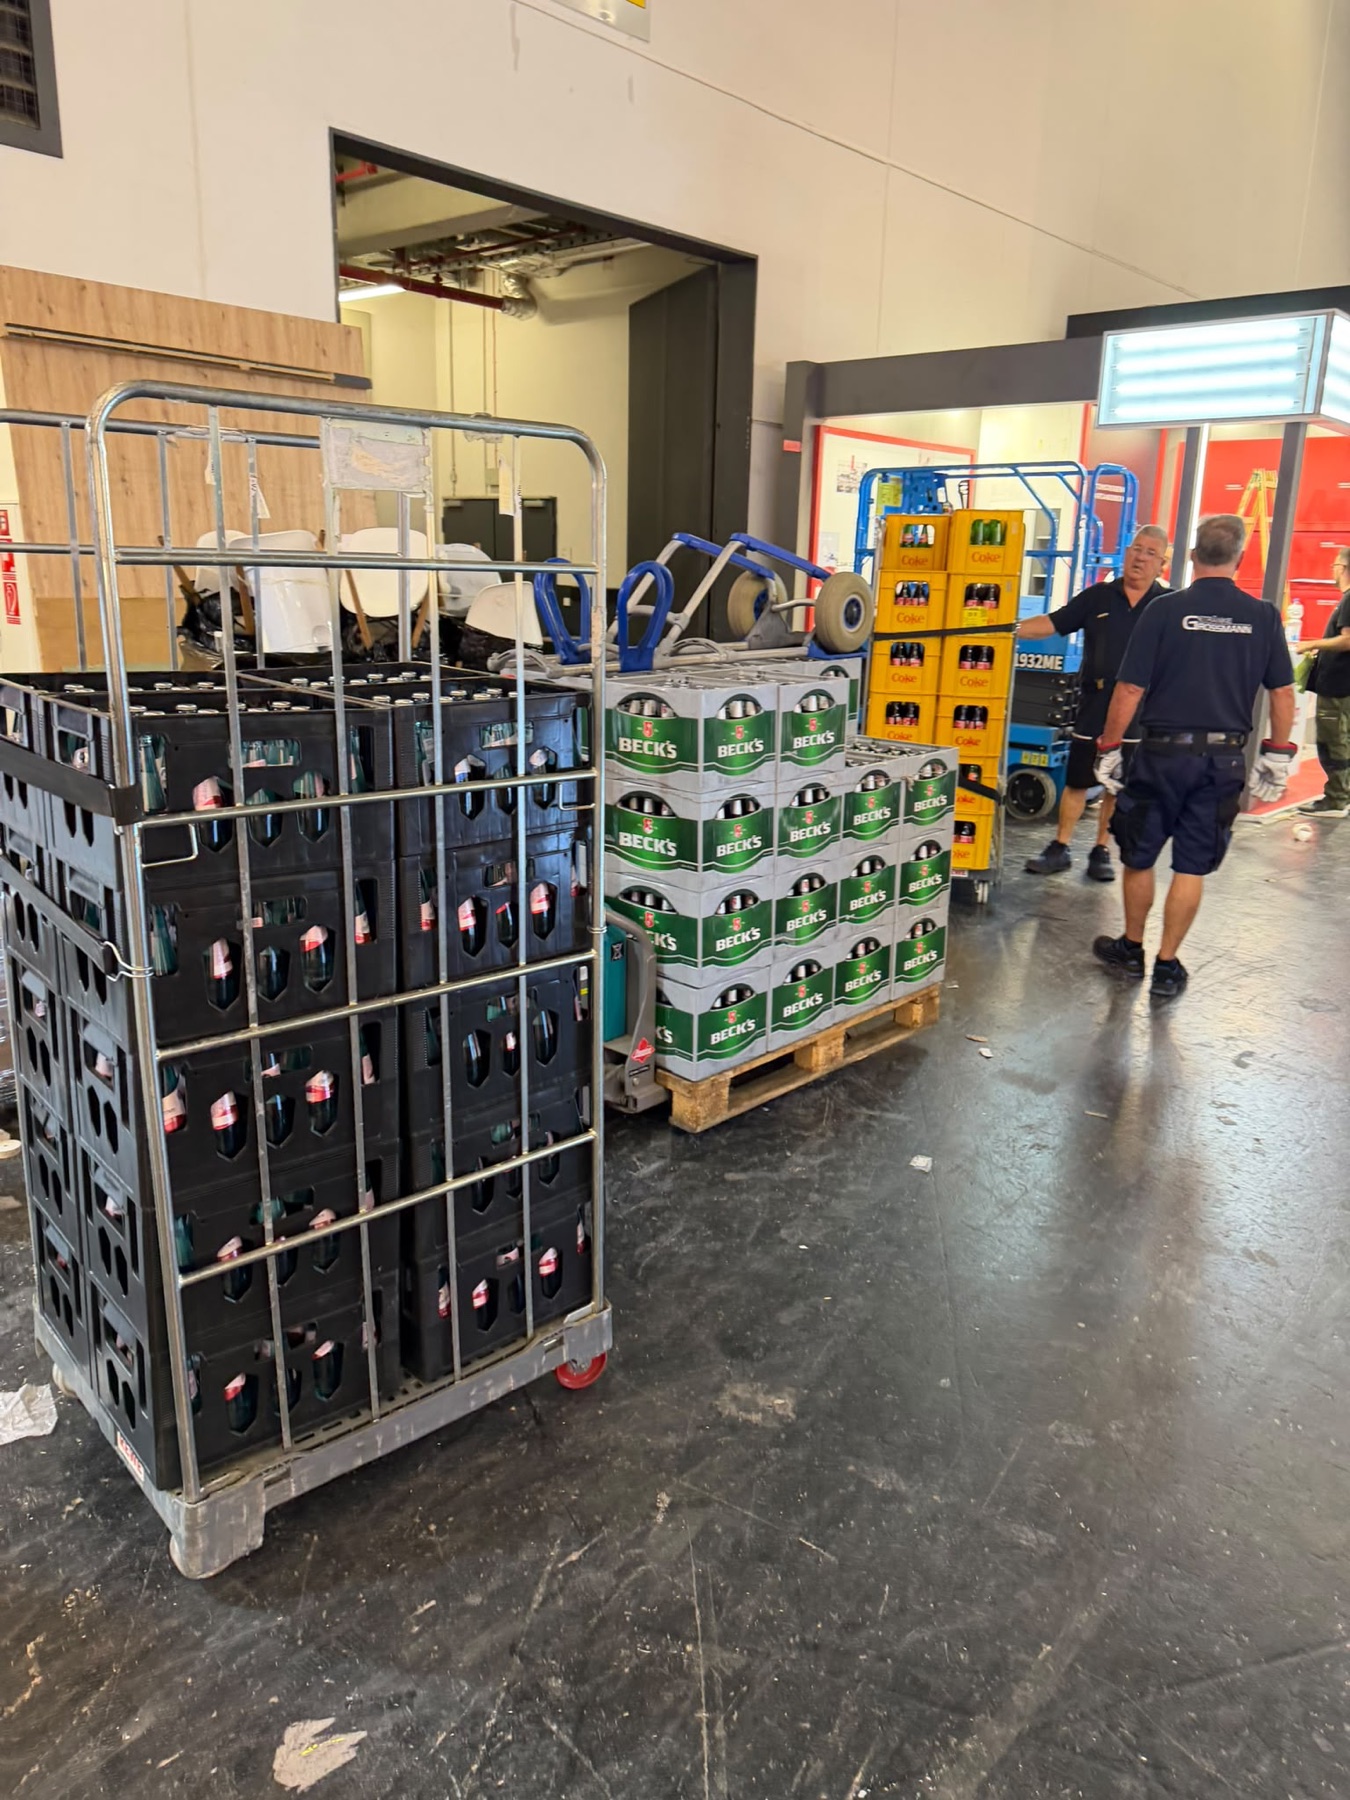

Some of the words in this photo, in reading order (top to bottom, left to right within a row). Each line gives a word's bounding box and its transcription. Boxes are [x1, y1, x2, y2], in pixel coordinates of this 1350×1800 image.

[901, 555, 928, 567] Coke
[972, 551, 1000, 564] Coke
[896, 612, 925, 624] Coke
[891, 673, 917, 683] Coke
[960, 676, 989, 687] Coke
[792, 730, 835, 750] BECK'S
[887, 731, 913, 740] Coke
[955, 736, 981, 746] Coke
[618, 737, 677, 759] BECK'S
[717, 737, 764, 758] BECK'S
[914, 793, 948, 813] BECK'S
[957, 794, 975, 804] oke
[853, 805, 891, 826] BECK'S
[789, 822, 831, 843] BECK'S
[618, 832, 677, 857] BECK'S
[716, 835, 762, 857] BECK'S
[908, 872, 942, 893] BECK'S
[850, 890, 887, 911] BECK'S
[786, 909, 827, 932] BECK'S
[715, 928, 761, 952] BECK'S
[904, 950, 938, 971] BECK'S
[845, 970, 882, 992] BECK'S
[783, 992, 823, 1018] BECK'S
[710, 1019, 756, 1045] BECK'S
